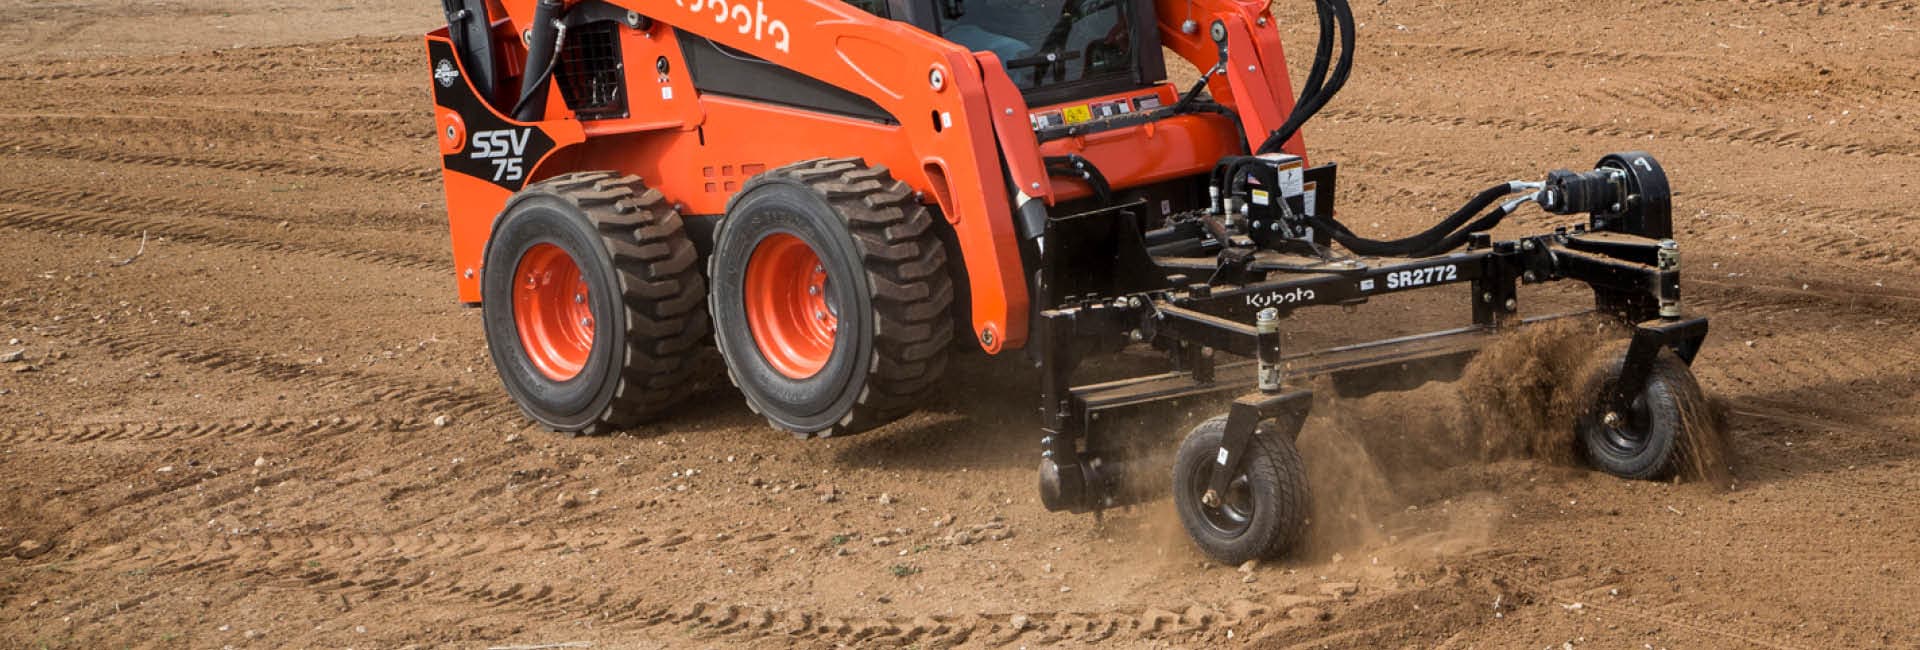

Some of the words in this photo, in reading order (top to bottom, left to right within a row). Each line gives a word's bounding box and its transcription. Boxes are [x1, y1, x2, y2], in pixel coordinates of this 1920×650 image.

[470, 128, 531, 158] SSV
[491, 157, 523, 181] 75
[1386, 264, 1457, 289] SR2772
[1246, 287, 1315, 307] Kubota
